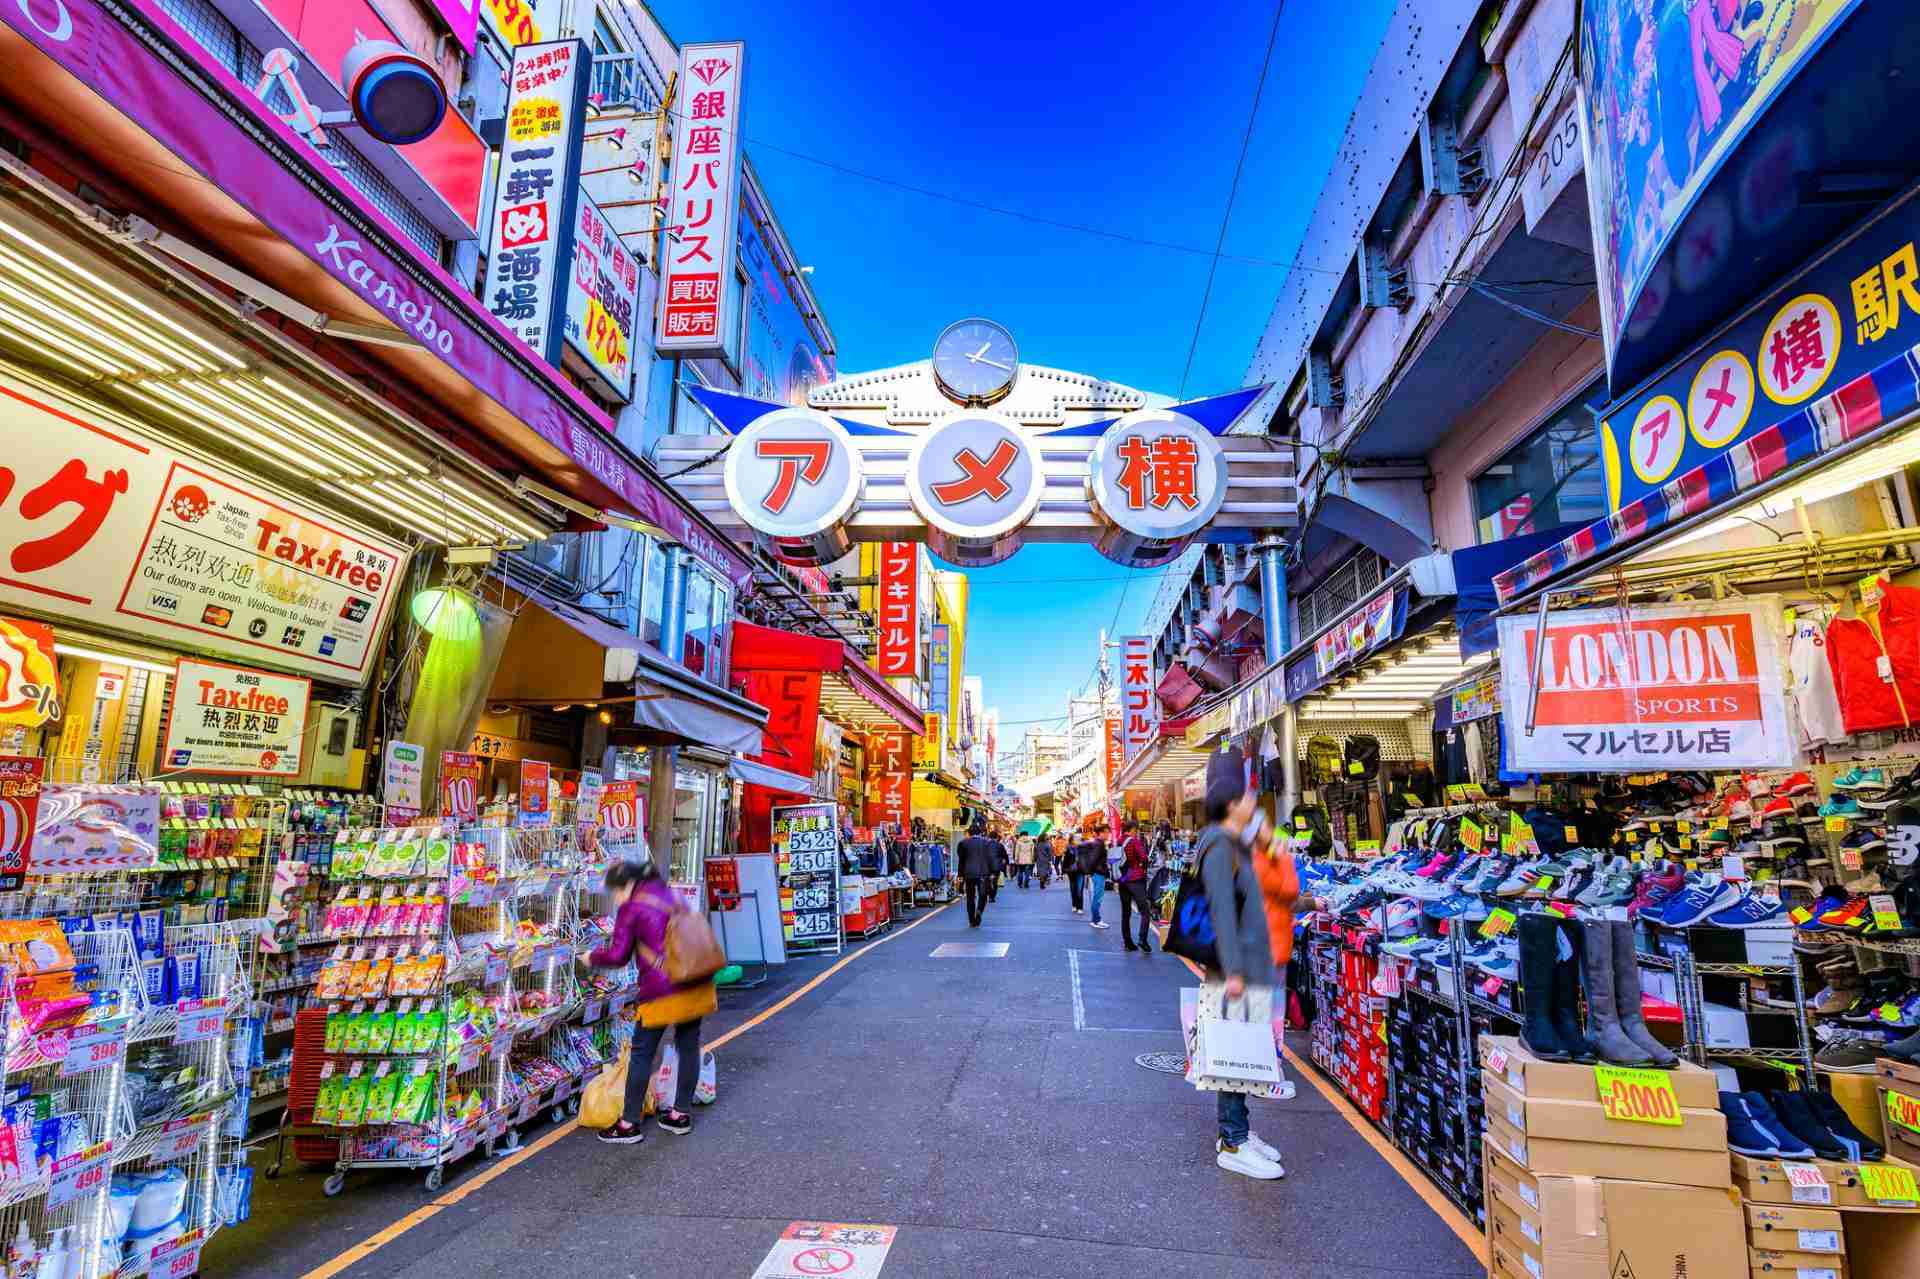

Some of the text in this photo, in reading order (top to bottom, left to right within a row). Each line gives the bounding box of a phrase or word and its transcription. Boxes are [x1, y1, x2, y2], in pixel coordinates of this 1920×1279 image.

[1538, 110, 1578, 190] 205
[677, 92, 725, 264] 銀座パリス
[314, 224, 454, 355] Kanebo
[671, 279, 715, 301] 買取
[667, 311, 714, 334] 販売
[223, 526, 244, 540] Shop
[149, 535, 255, 589] 热烈欢迎
[257, 518, 382, 592] Tax-free
[143, 566, 165, 584] Our
[167, 574, 196, 594] doors
[198, 584, 216, 598] are
[247, 598, 287, 619] Welcome
[289, 610, 299, 621] to
[151, 595, 177, 611] VISA
[250, 622, 267, 635] UC
[1541, 624, 1739, 690] LONDON
[198, 679, 289, 714] Tax-free
[1635, 696, 1739, 716] SPORTS
[203, 708, 279, 734] 热烈欢迎
[1562, 728, 1731, 755] マルセル店
